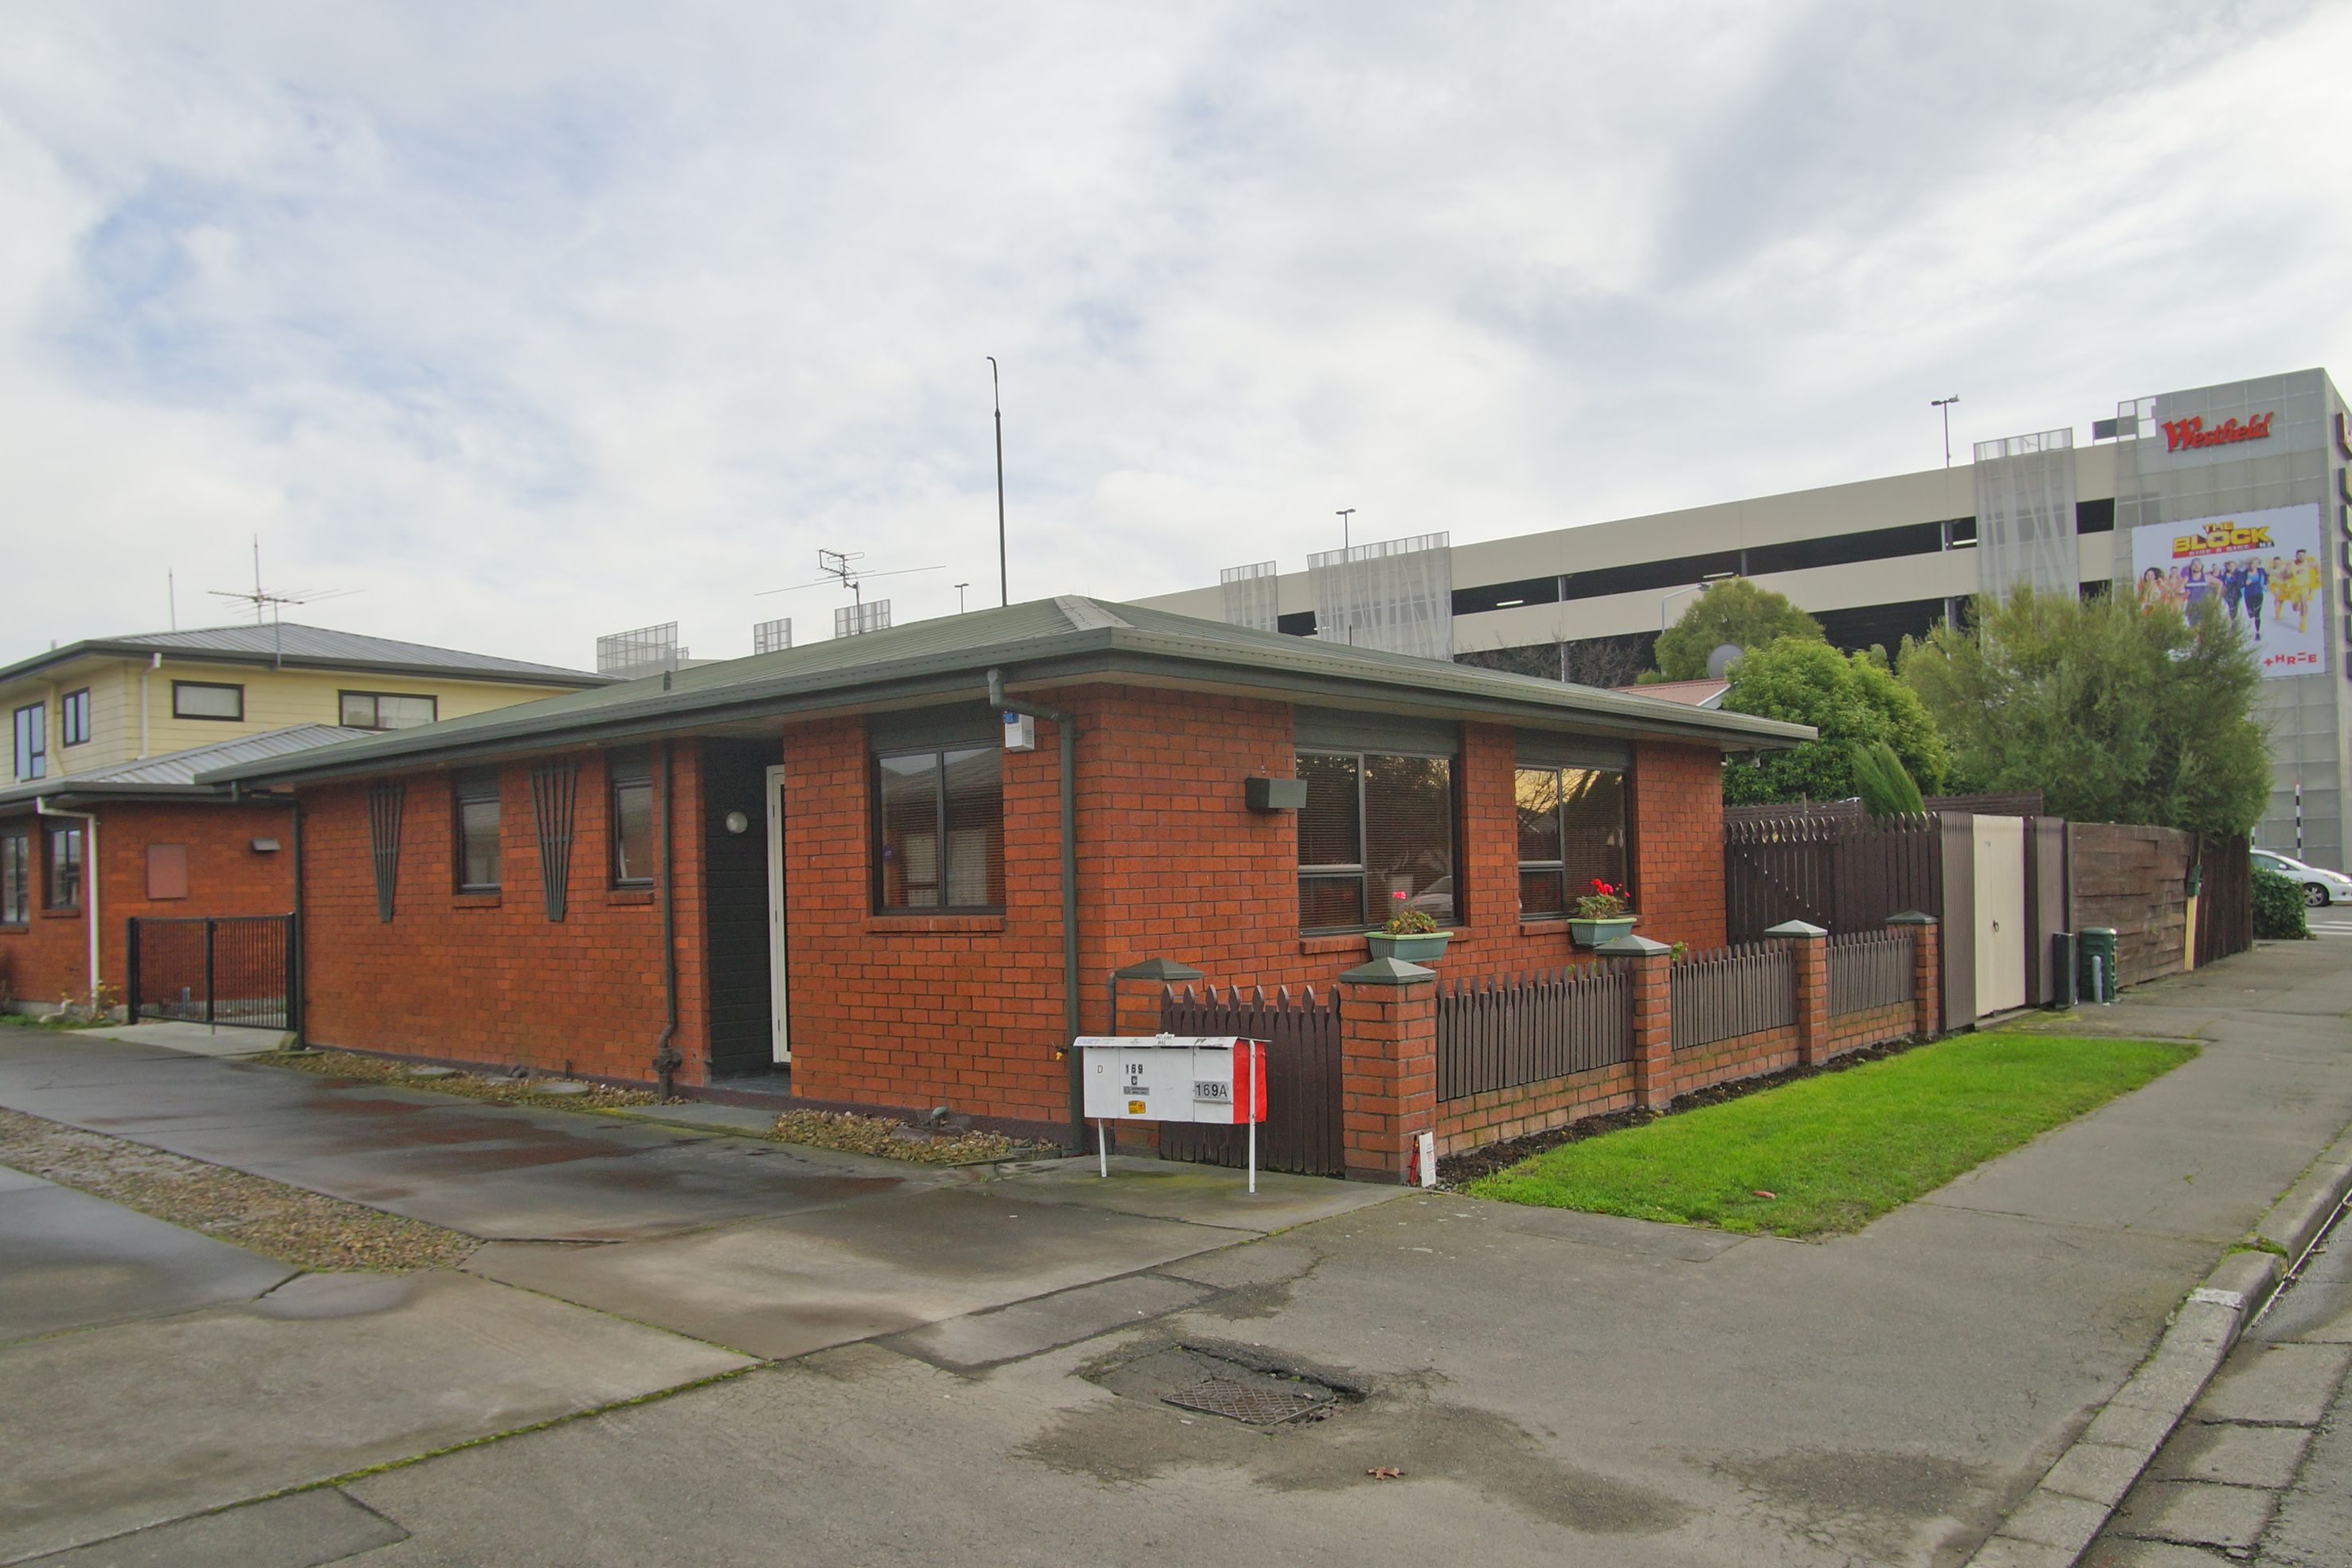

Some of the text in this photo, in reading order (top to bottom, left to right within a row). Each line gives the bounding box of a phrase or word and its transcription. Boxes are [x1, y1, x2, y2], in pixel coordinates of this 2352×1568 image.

[2161, 412, 2274, 452] Westfield
[2203, 522, 2233, 533] THE
[2173, 526, 2272, 553] BLOCK
[1125, 1064, 1143, 1073] 169
[1131, 1076, 1137, 1085] C
[1196, 1084, 1228, 1097] 169A
